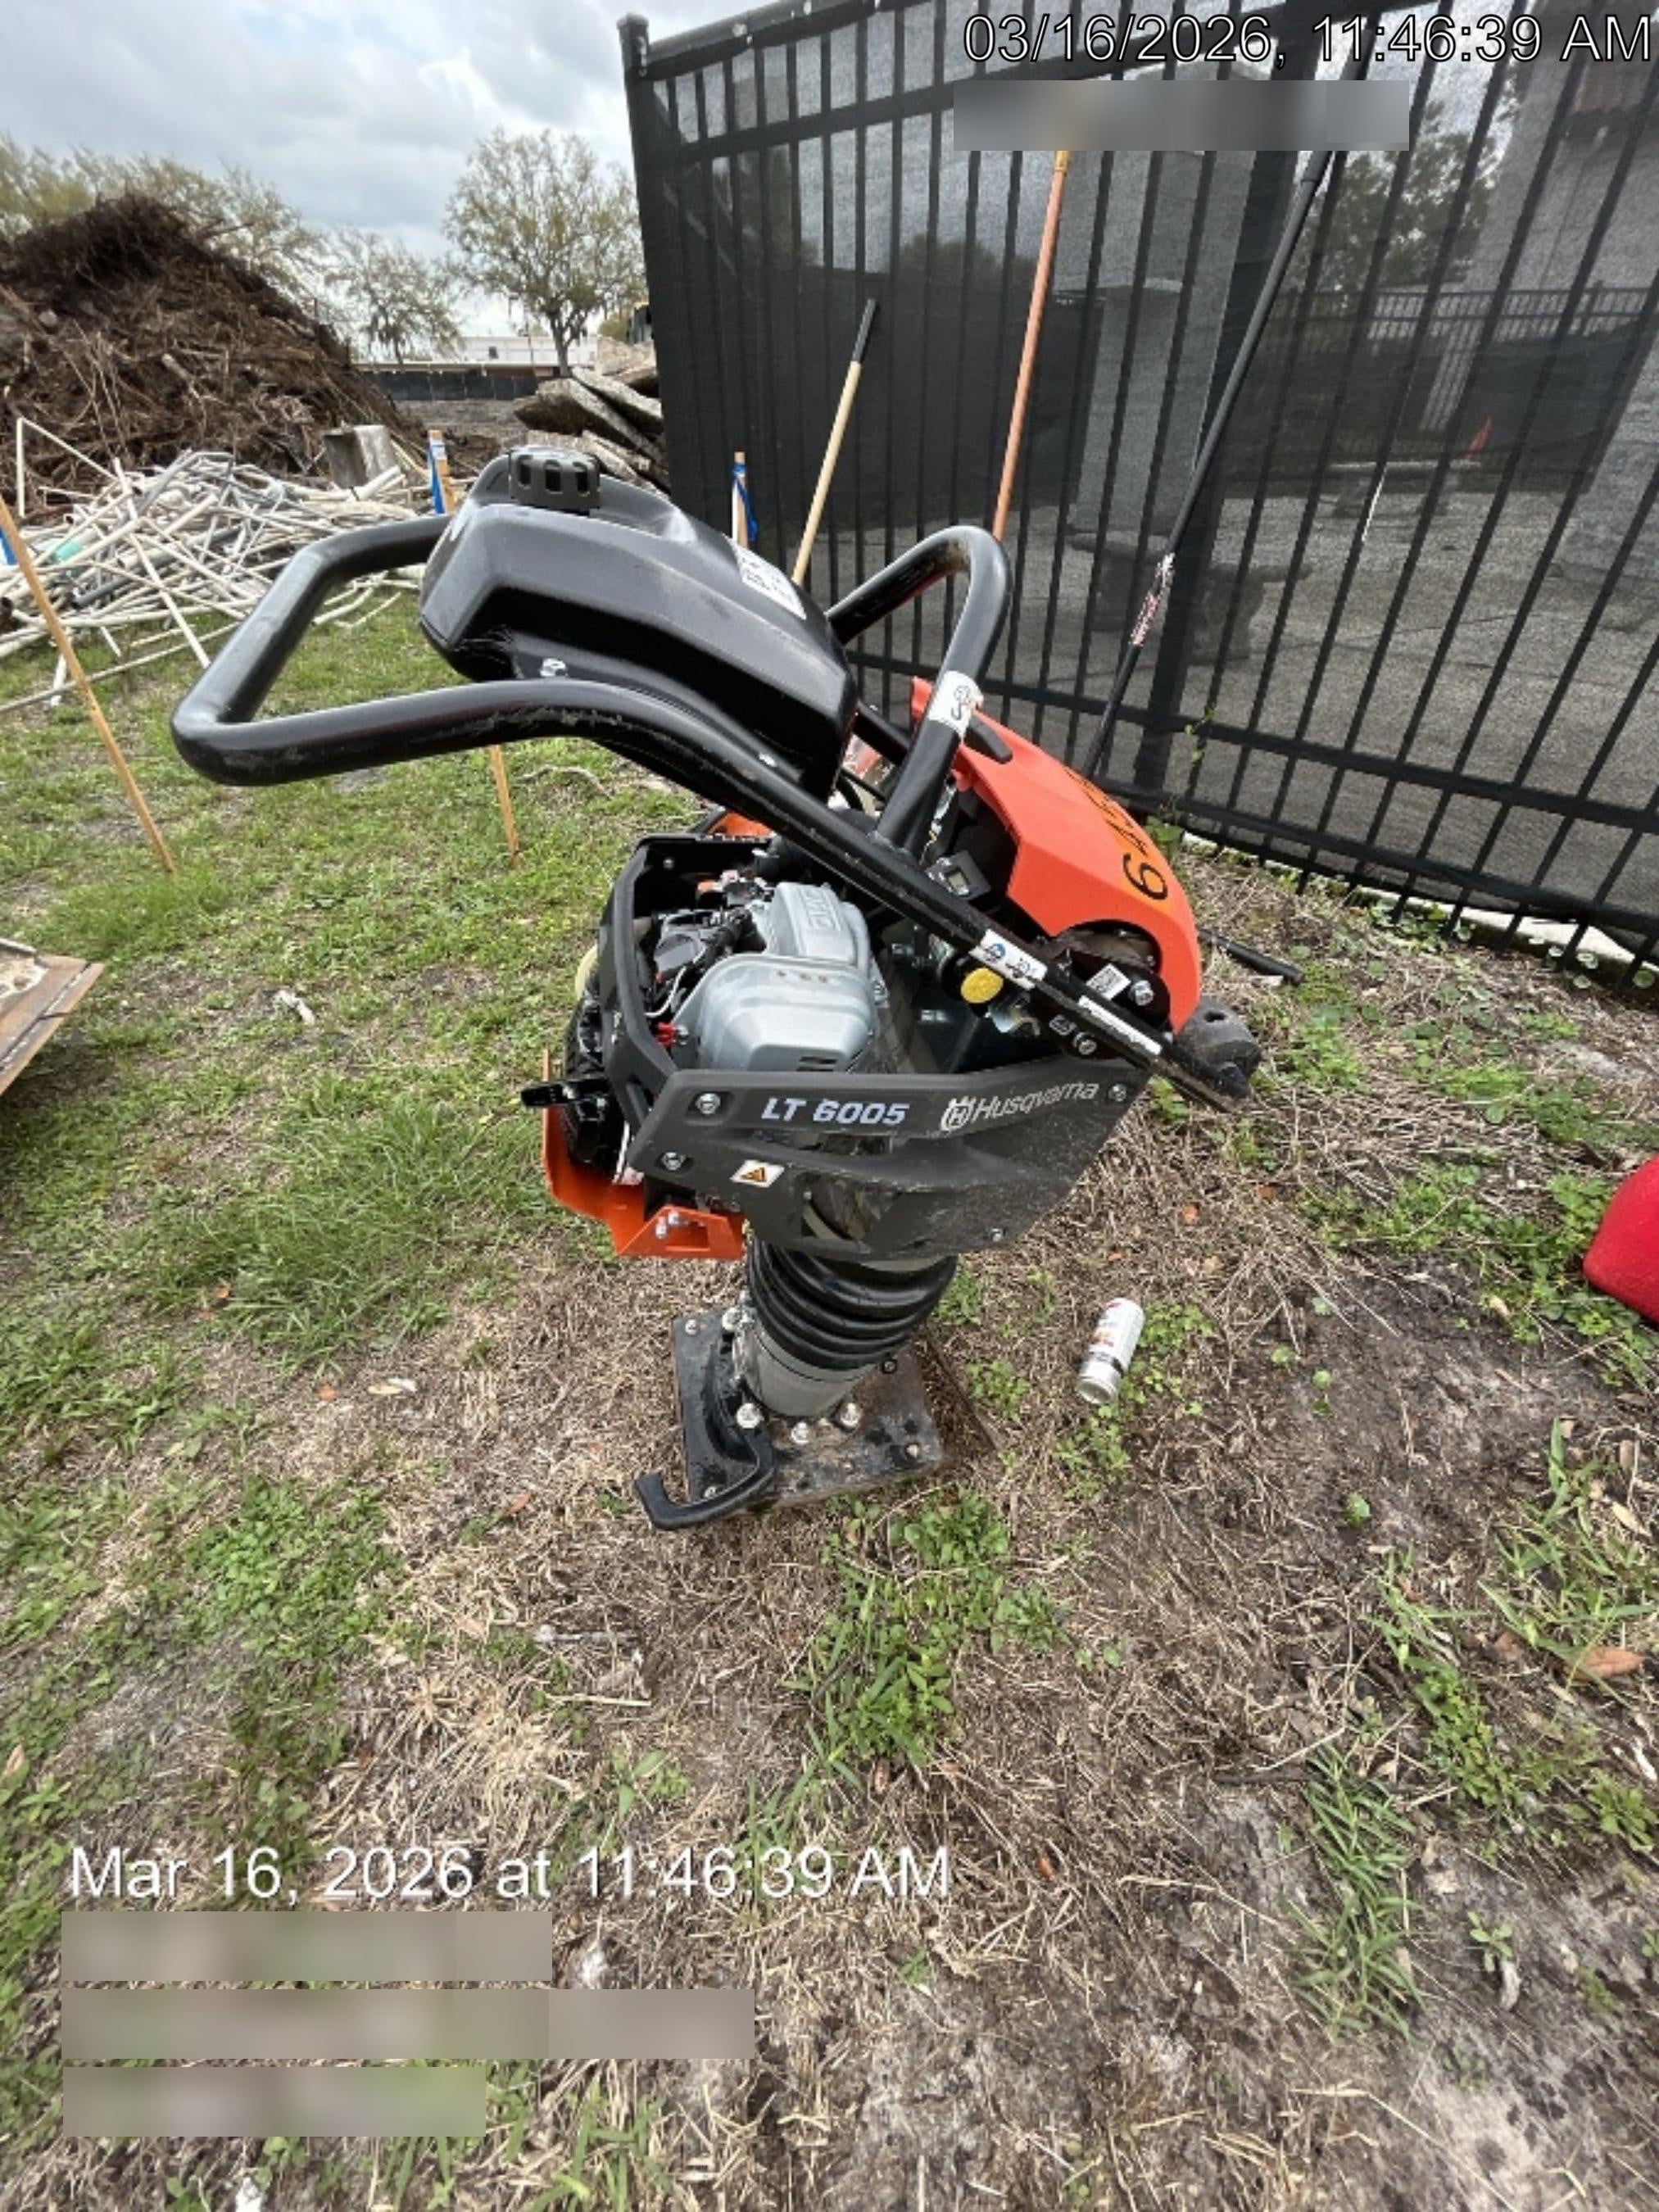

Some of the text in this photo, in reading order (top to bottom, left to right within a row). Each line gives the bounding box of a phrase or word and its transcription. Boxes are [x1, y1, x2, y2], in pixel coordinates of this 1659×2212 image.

[761, 1098, 909, 1125] LT 6005
[971, 1083, 1099, 1124] Husqvarna
